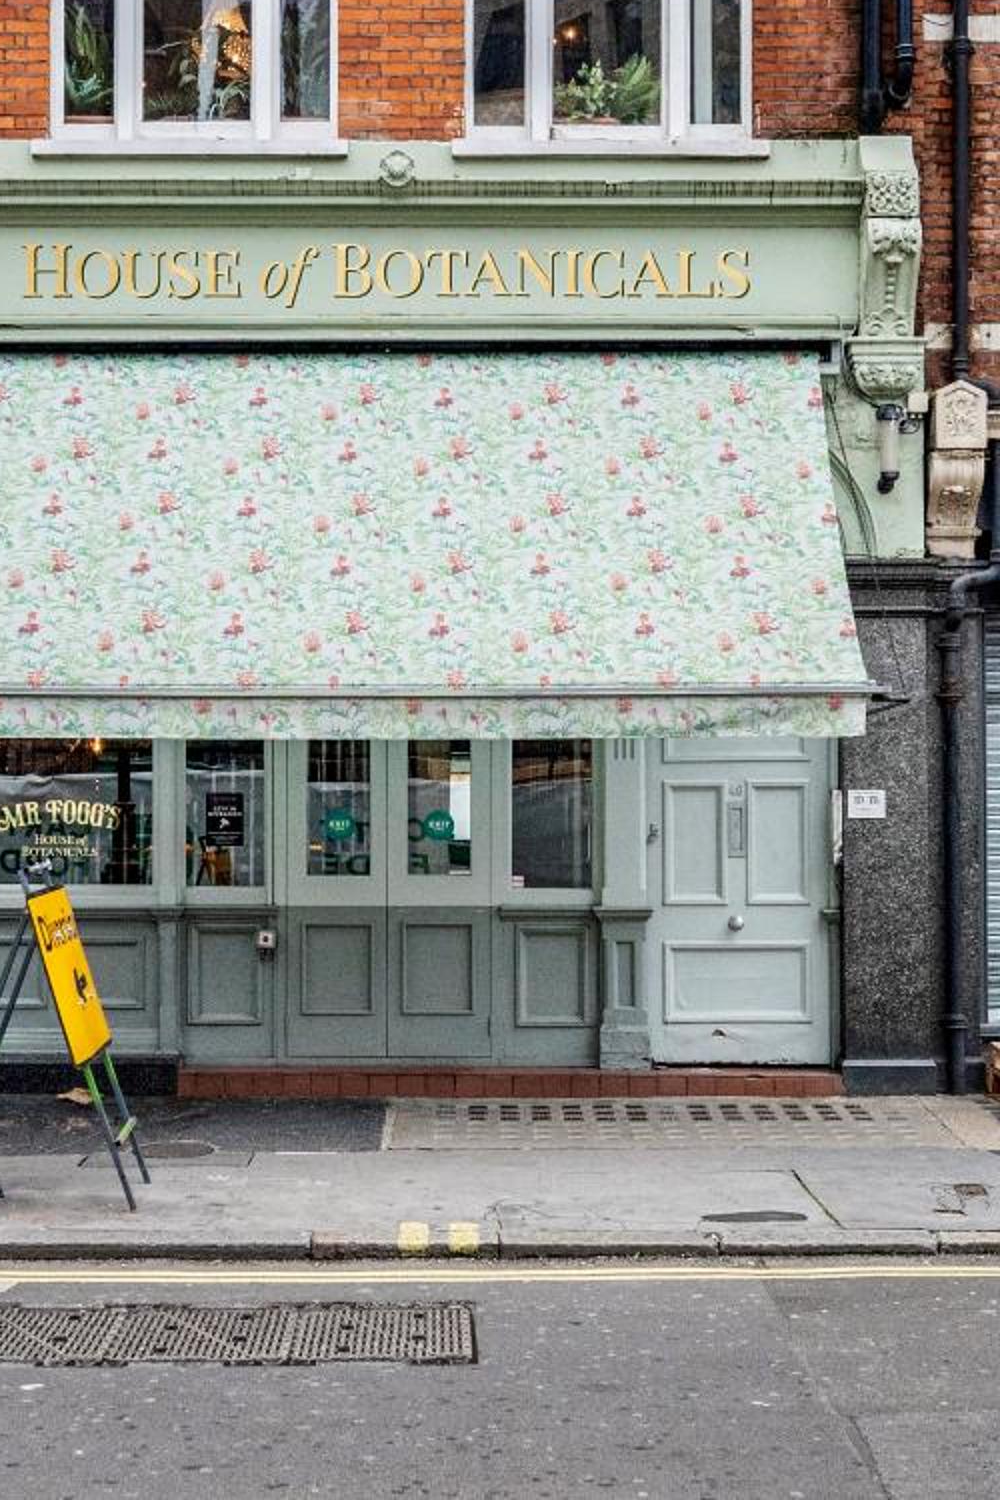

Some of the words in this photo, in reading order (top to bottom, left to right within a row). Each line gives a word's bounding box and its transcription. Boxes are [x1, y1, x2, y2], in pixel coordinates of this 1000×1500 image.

[21, 244, 242, 300] HOUSE
[259, 246, 320, 309] of
[332, 243, 751, 300] BOTANICALS
[45, 799, 122, 831] FOGG'S
[34, 833, 76, 846] HOUSE
